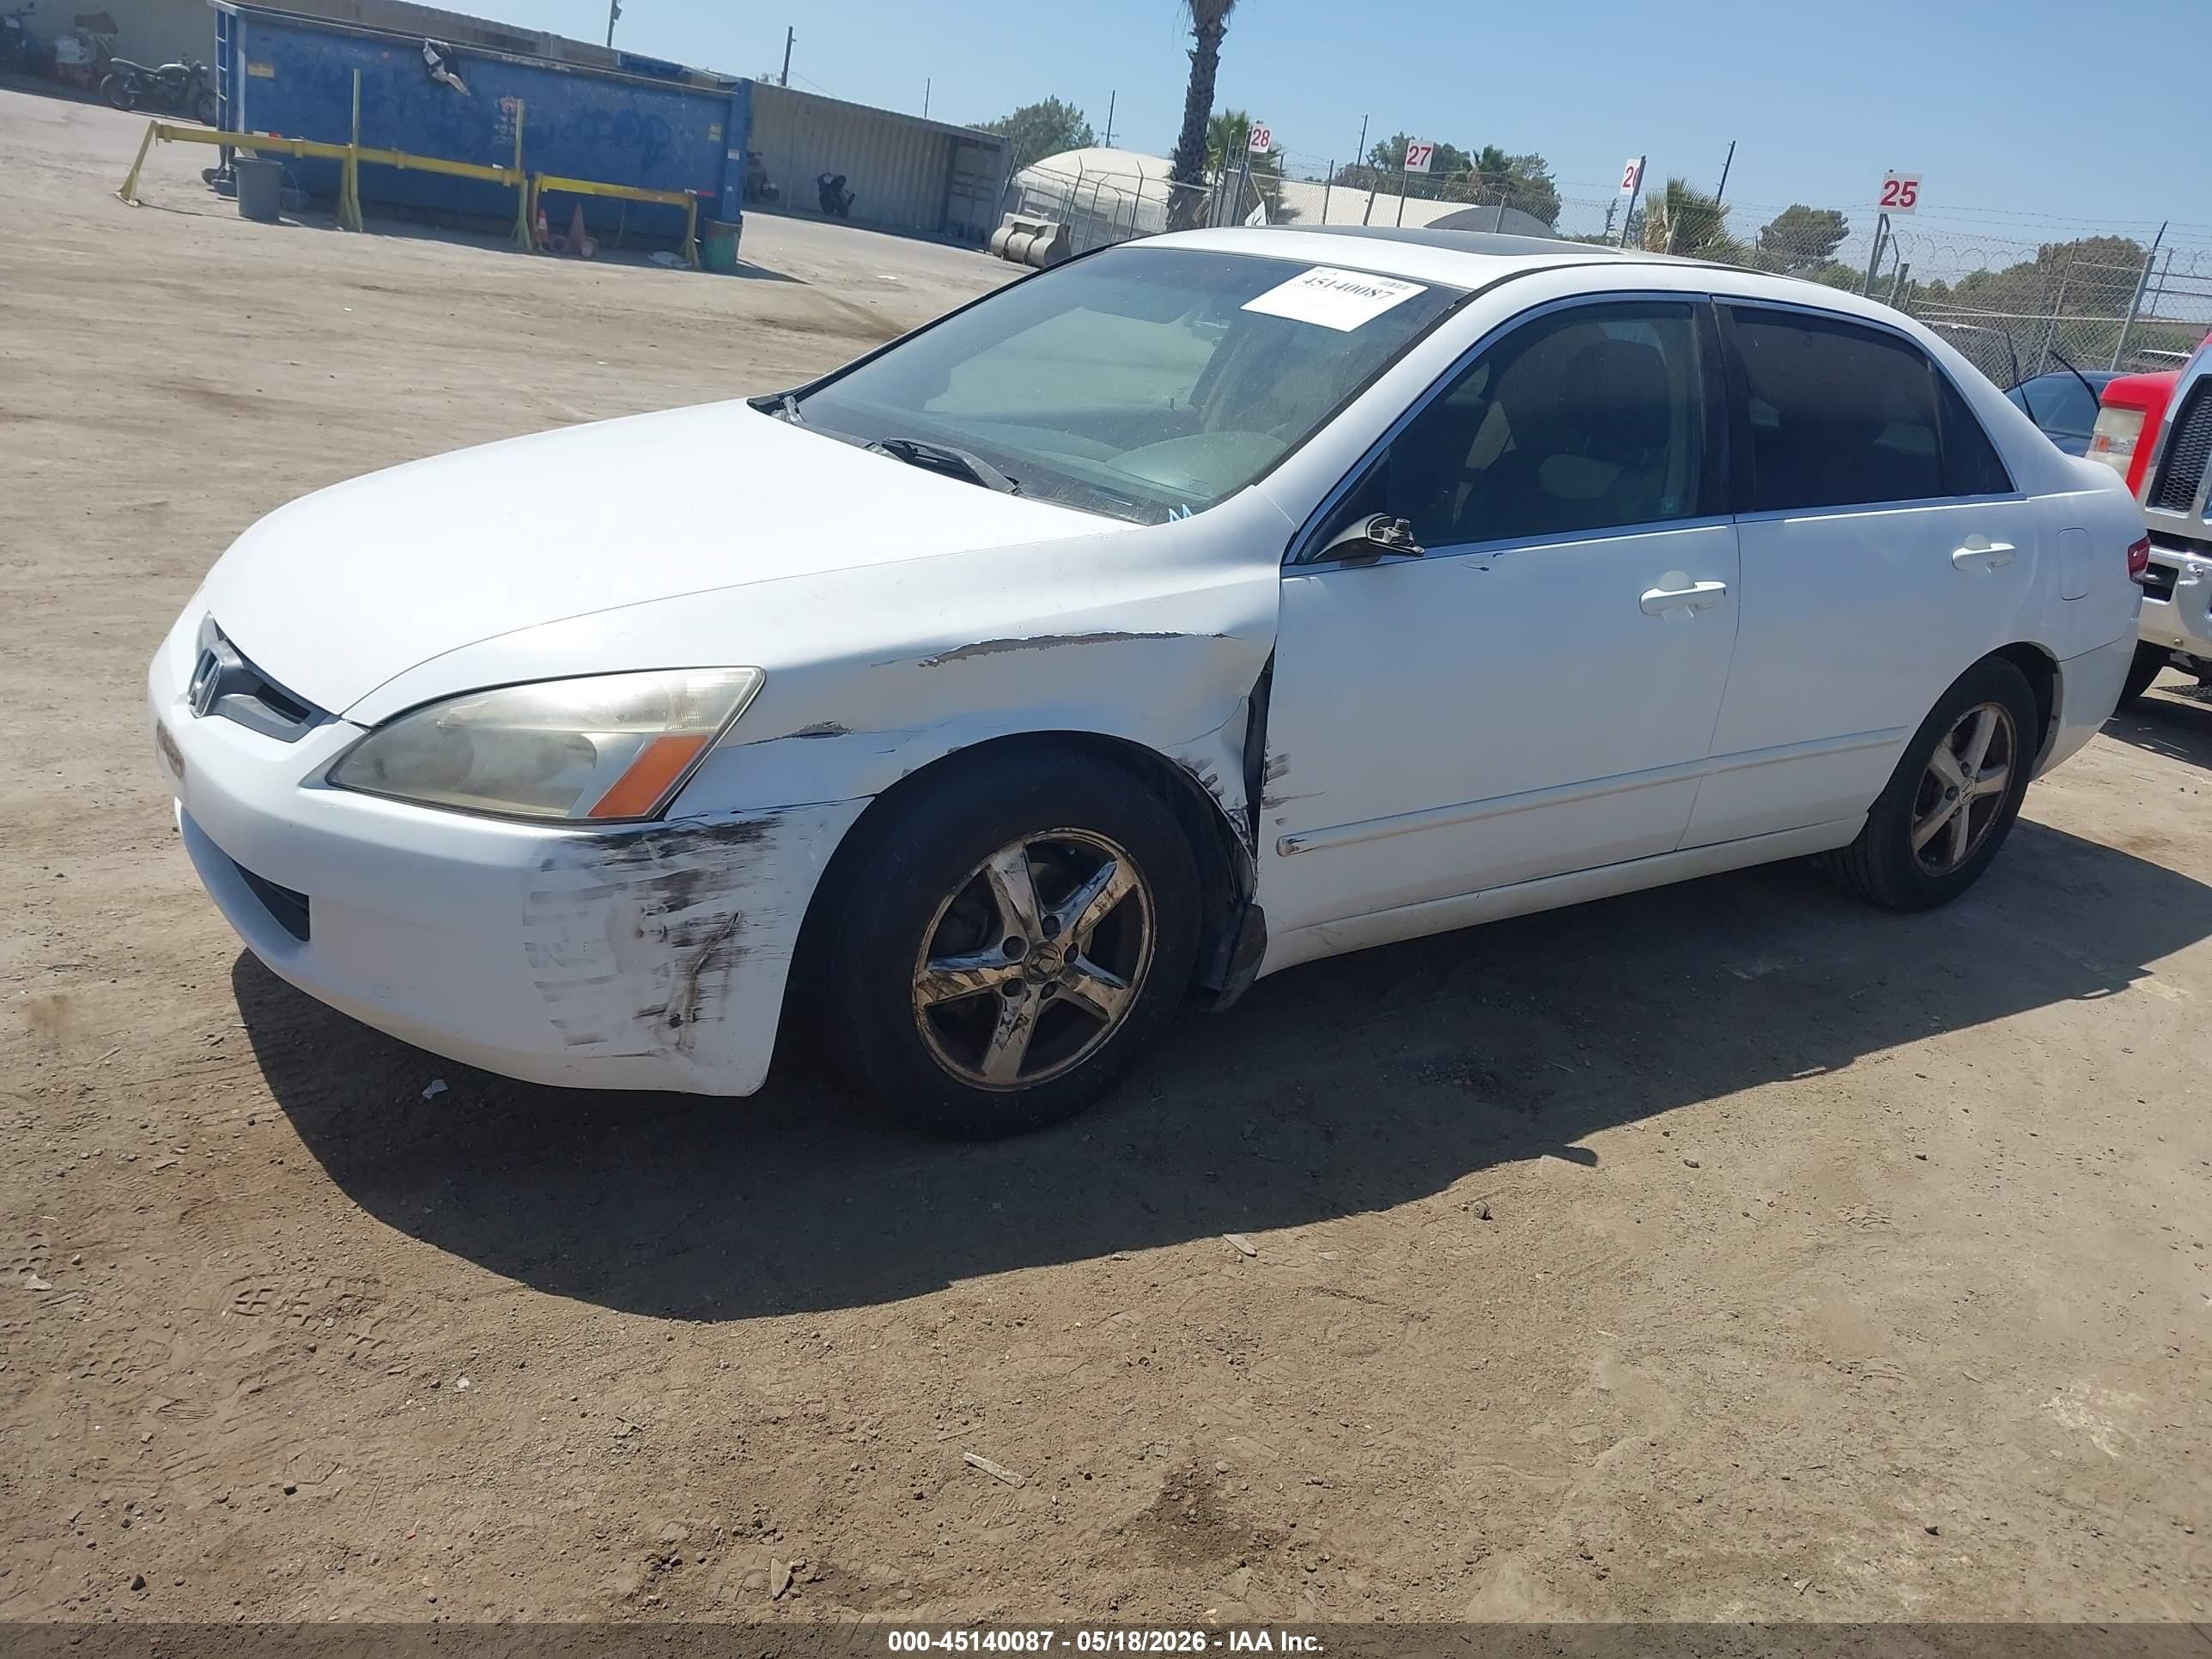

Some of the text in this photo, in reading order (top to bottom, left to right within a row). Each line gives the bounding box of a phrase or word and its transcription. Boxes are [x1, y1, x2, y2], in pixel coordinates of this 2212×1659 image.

[1250, 129, 1271, 147] 28
[1406, 145, 1431, 167] 27
[1880, 180, 1918, 207] 25
[1302, 276, 1396, 301] 45140087
